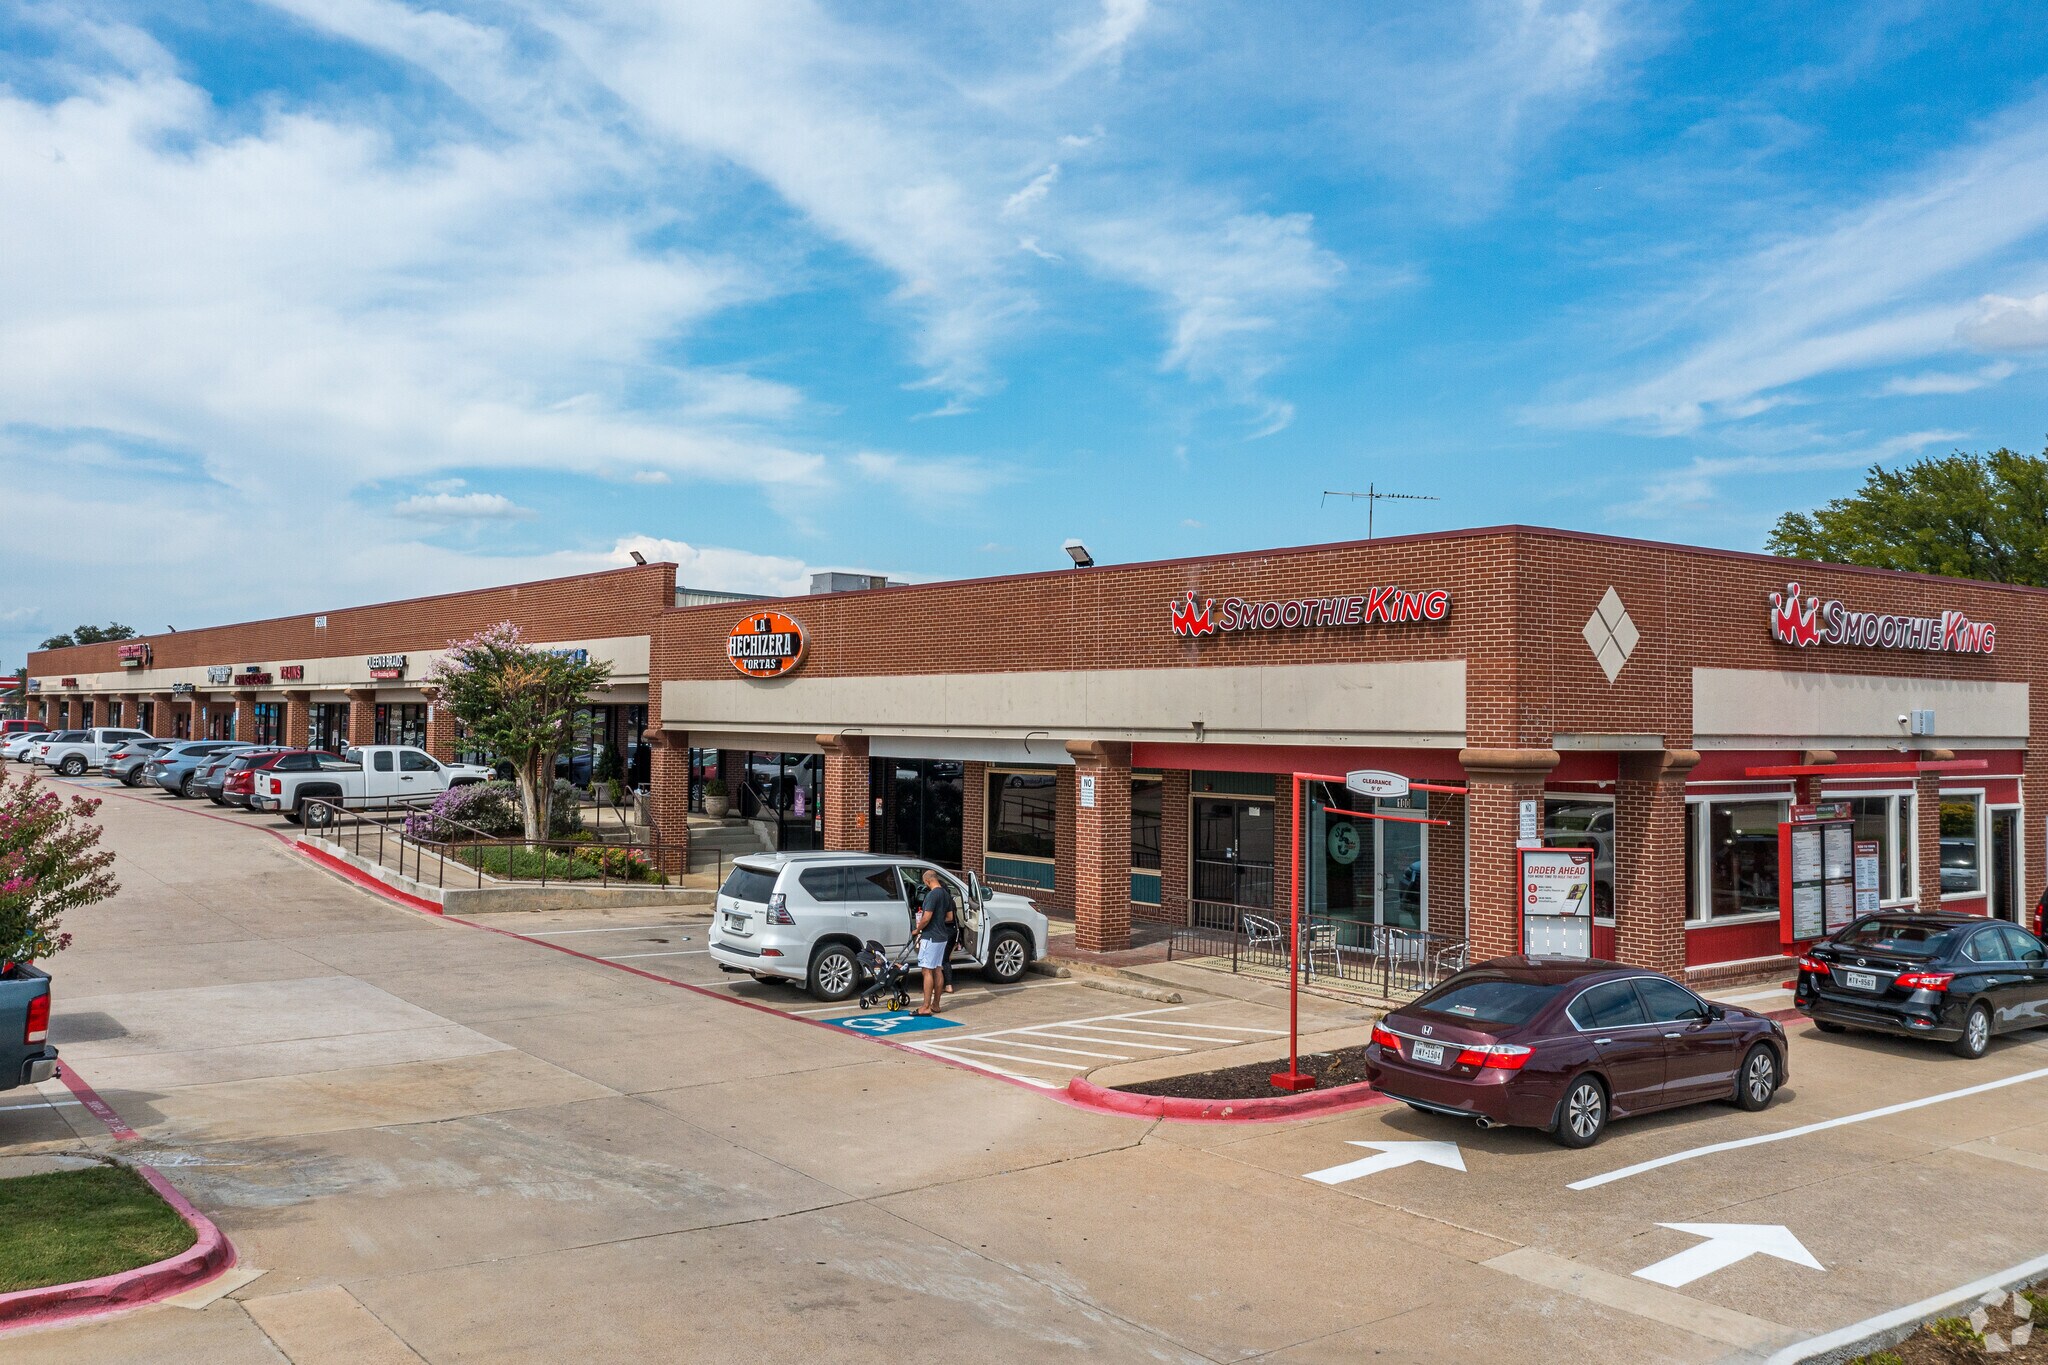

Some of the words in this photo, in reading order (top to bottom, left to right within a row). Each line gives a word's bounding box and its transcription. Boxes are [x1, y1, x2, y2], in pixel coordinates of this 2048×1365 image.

[1218, 597, 1364, 631] SMOOTHIE
[754, 619, 766, 632] LA
[1824, 600, 1942, 650] SMOOTHIE
[729, 633, 792, 657] HECHIZERA
[367, 656, 382, 669] QUEEN
[386, 655, 403, 667] BRAIDS
[743, 659, 776, 669] TORTAS
[1083, 778, 1092, 787] NO
[1362, 778, 1392, 786] CLEARANCE
[1528, 866, 1556, 874] ORDER
[1558, 866, 1586, 874] AHEAD
